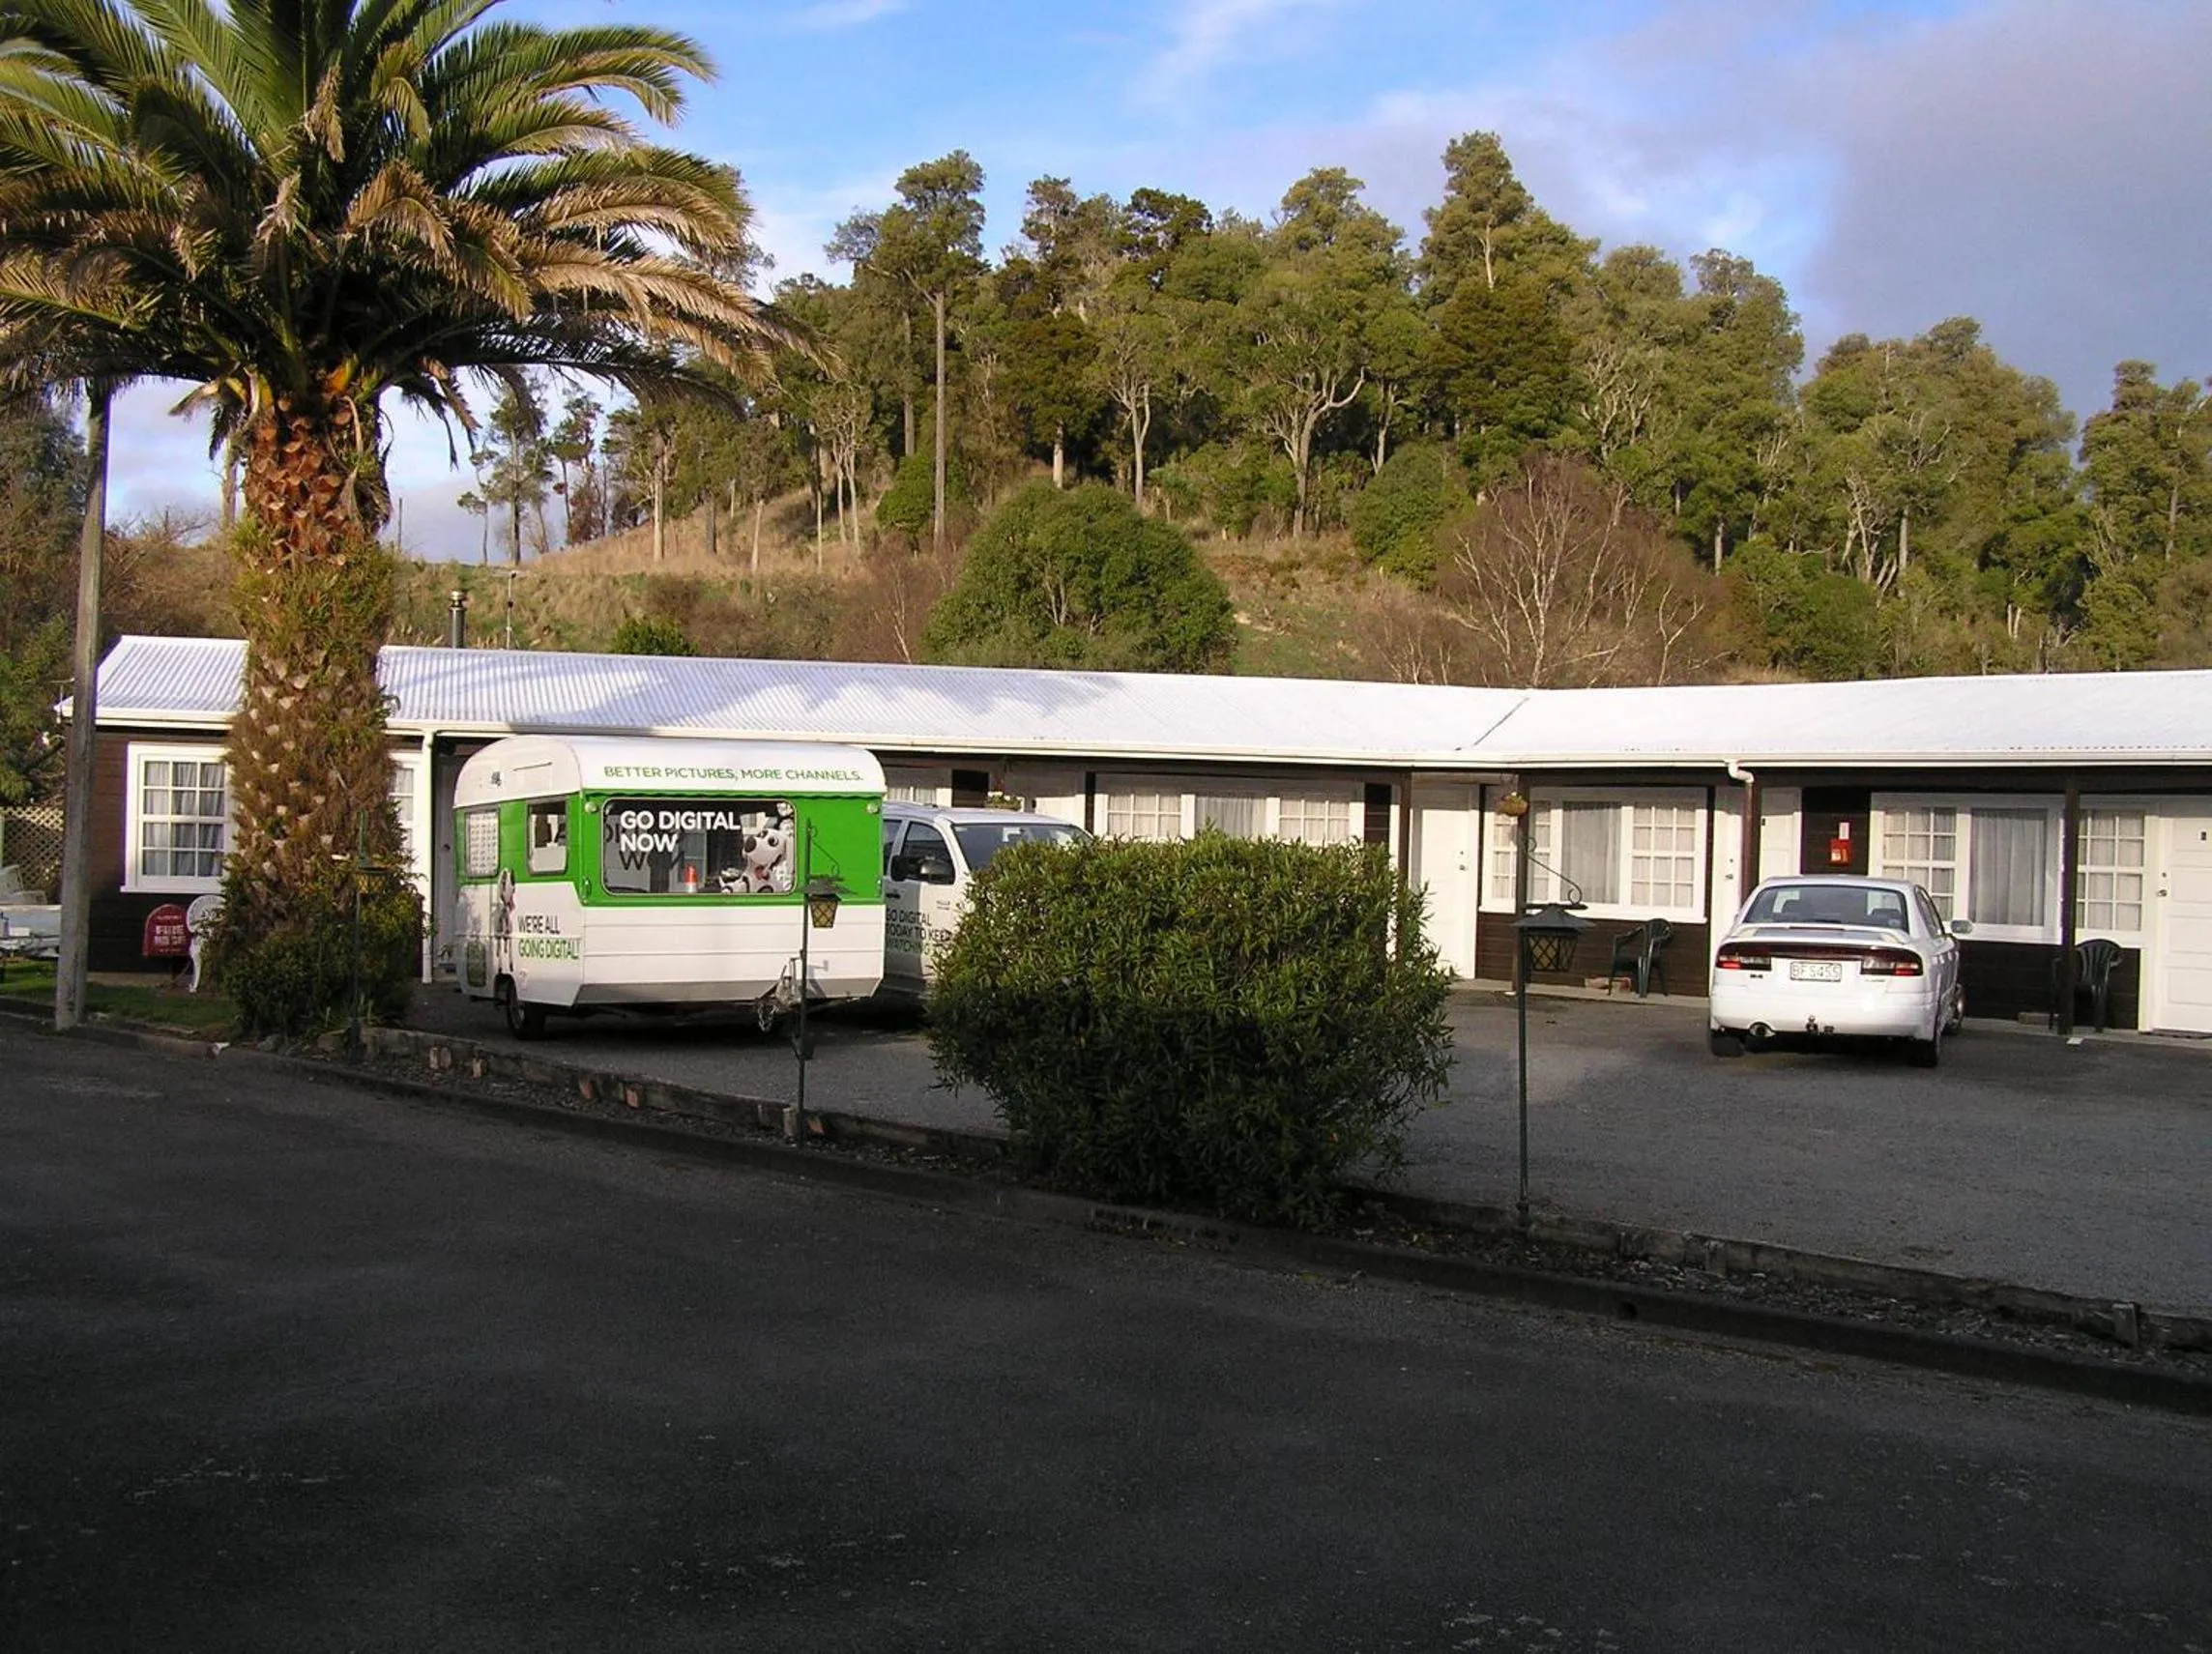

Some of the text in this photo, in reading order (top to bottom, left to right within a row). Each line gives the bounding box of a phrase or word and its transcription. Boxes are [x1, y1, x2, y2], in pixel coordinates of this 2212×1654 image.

[603, 766, 863, 781] BETTER PICTURES, MORE CHANNELS.
[620, 810, 742, 830] GO DIGITAL
[620, 832, 679, 853] NOW
[545, 914, 561, 935] ALL
[899, 909, 932, 927] DIGITAL
[914, 926, 927, 941] TO
[518, 938, 544, 958] GOING
